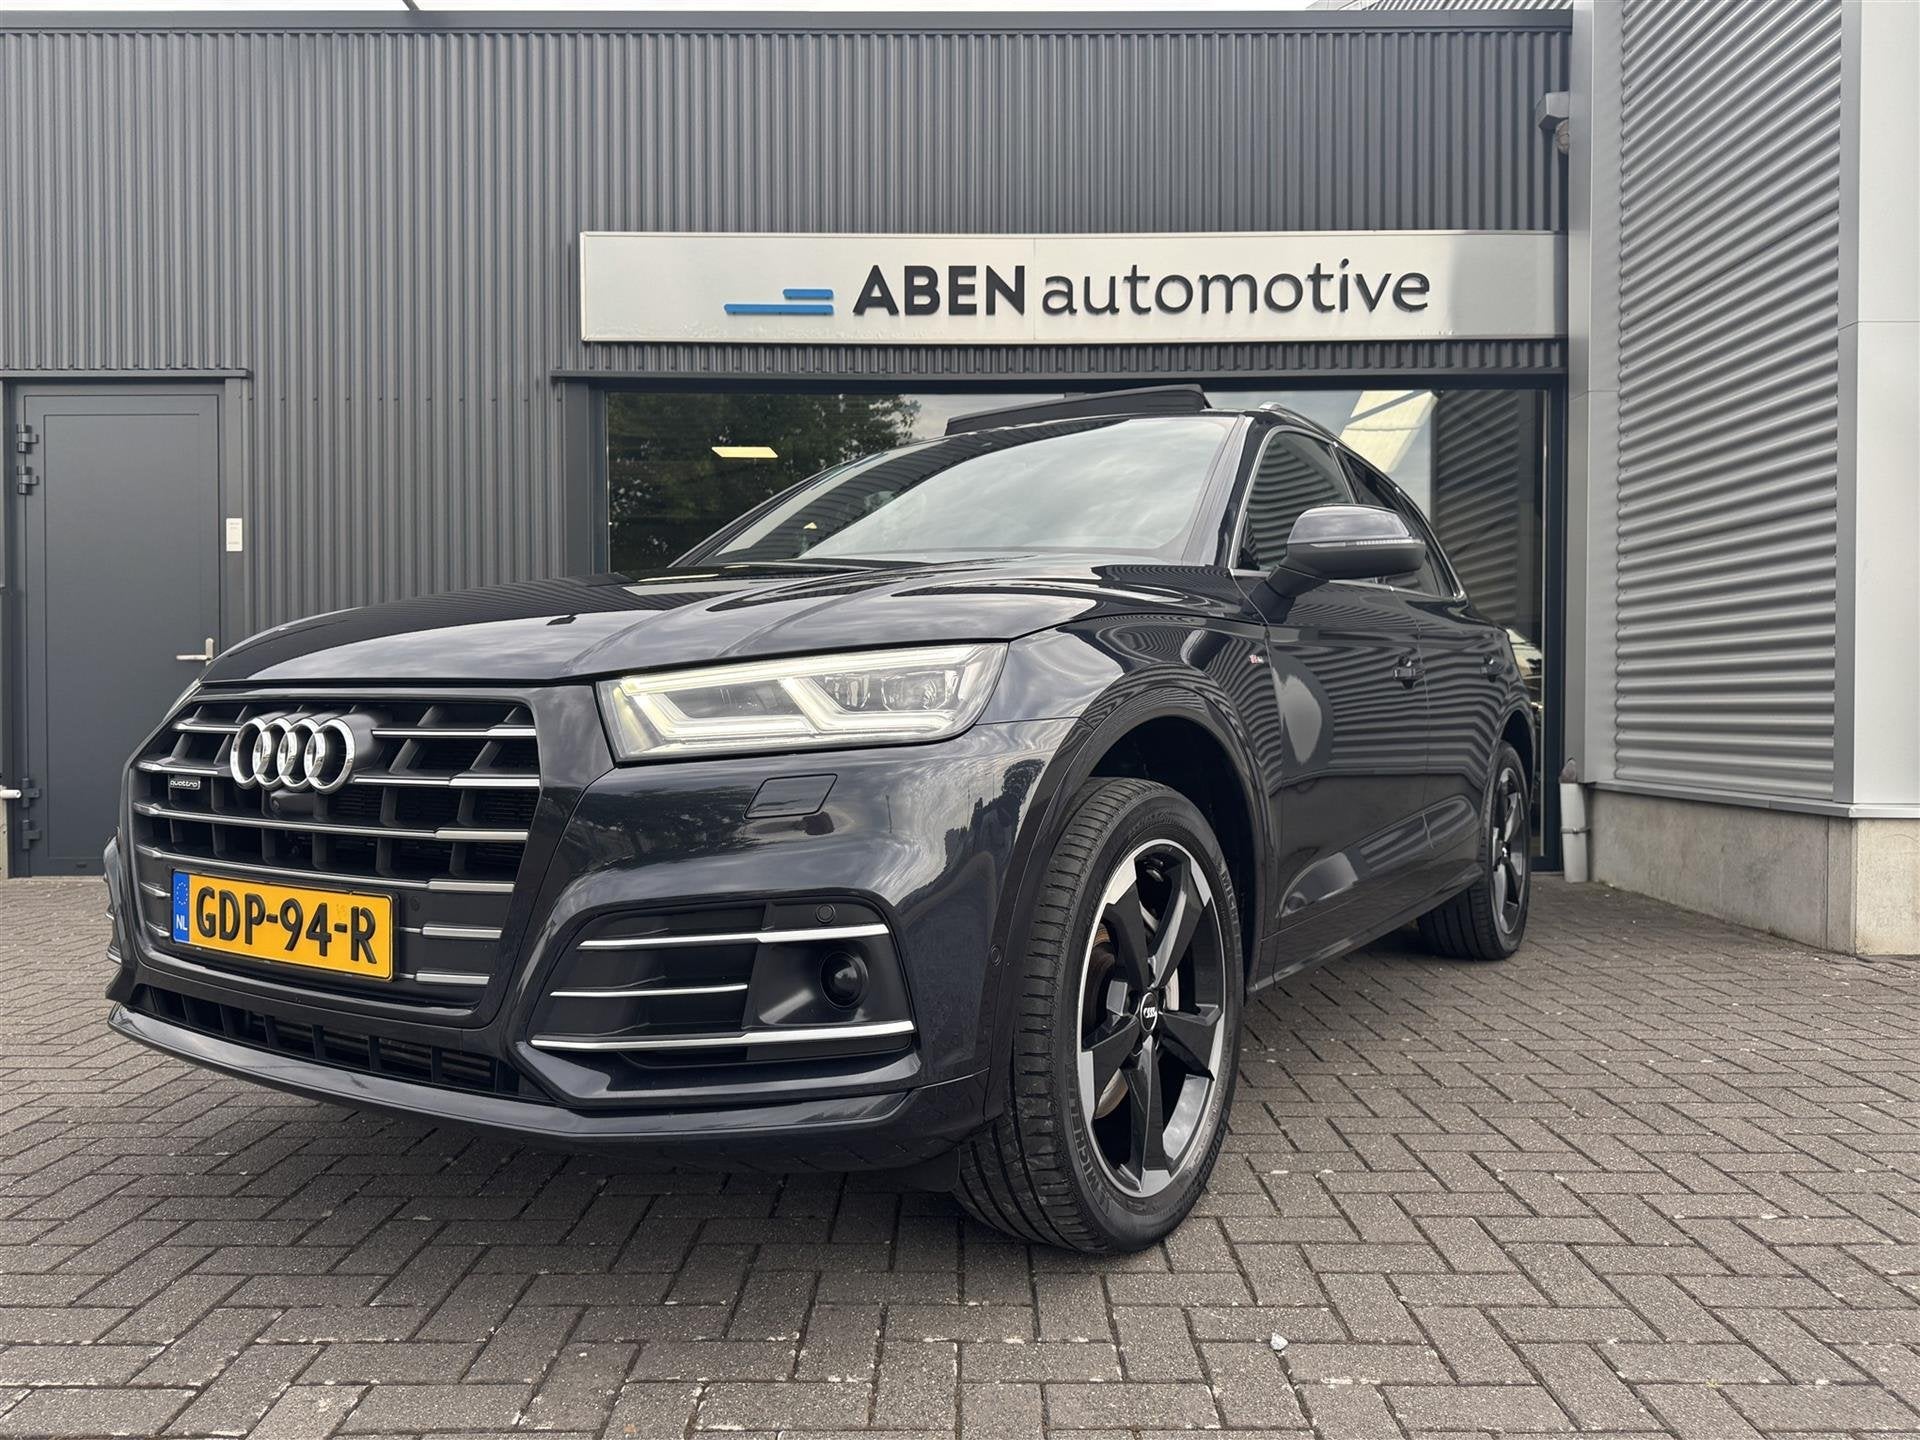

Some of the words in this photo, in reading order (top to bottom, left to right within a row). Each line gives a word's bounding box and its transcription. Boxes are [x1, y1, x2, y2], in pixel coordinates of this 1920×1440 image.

[852, 264, 1026, 316] ABEN
[1042, 258, 1430, 315] automotive
[170, 780, 198, 788] quattro
[176, 914, 188, 931] NL
[196, 886, 377, 964] GDP-94-R
